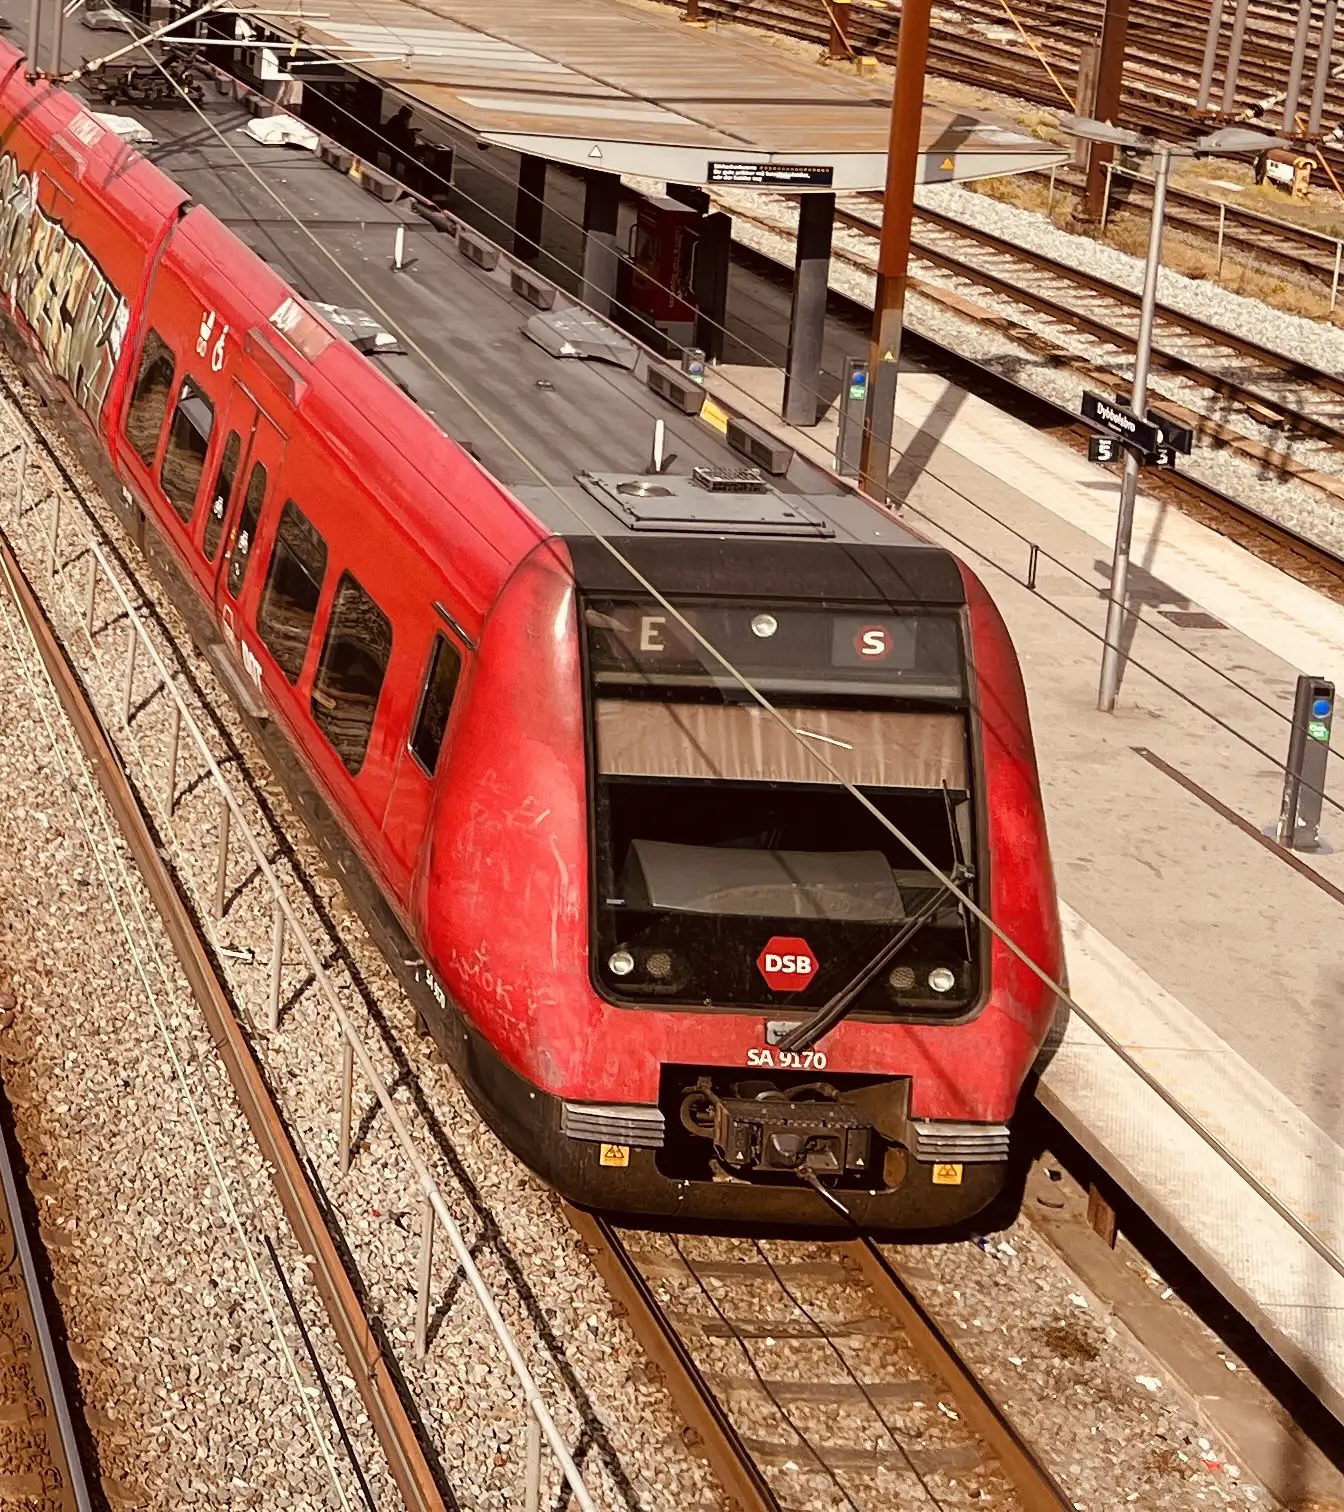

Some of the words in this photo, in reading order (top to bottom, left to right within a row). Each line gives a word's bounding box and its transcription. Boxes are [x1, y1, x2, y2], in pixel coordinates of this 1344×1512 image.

[1097, 445, 1111, 461] 5
[1156, 448, 1169, 464] 3
[640, 616, 666, 651] E
[861, 630, 885, 655] S
[765, 953, 812, 974] DSB
[746, 1048, 774, 1067] SA
[778, 1050, 827, 1070] 9170
